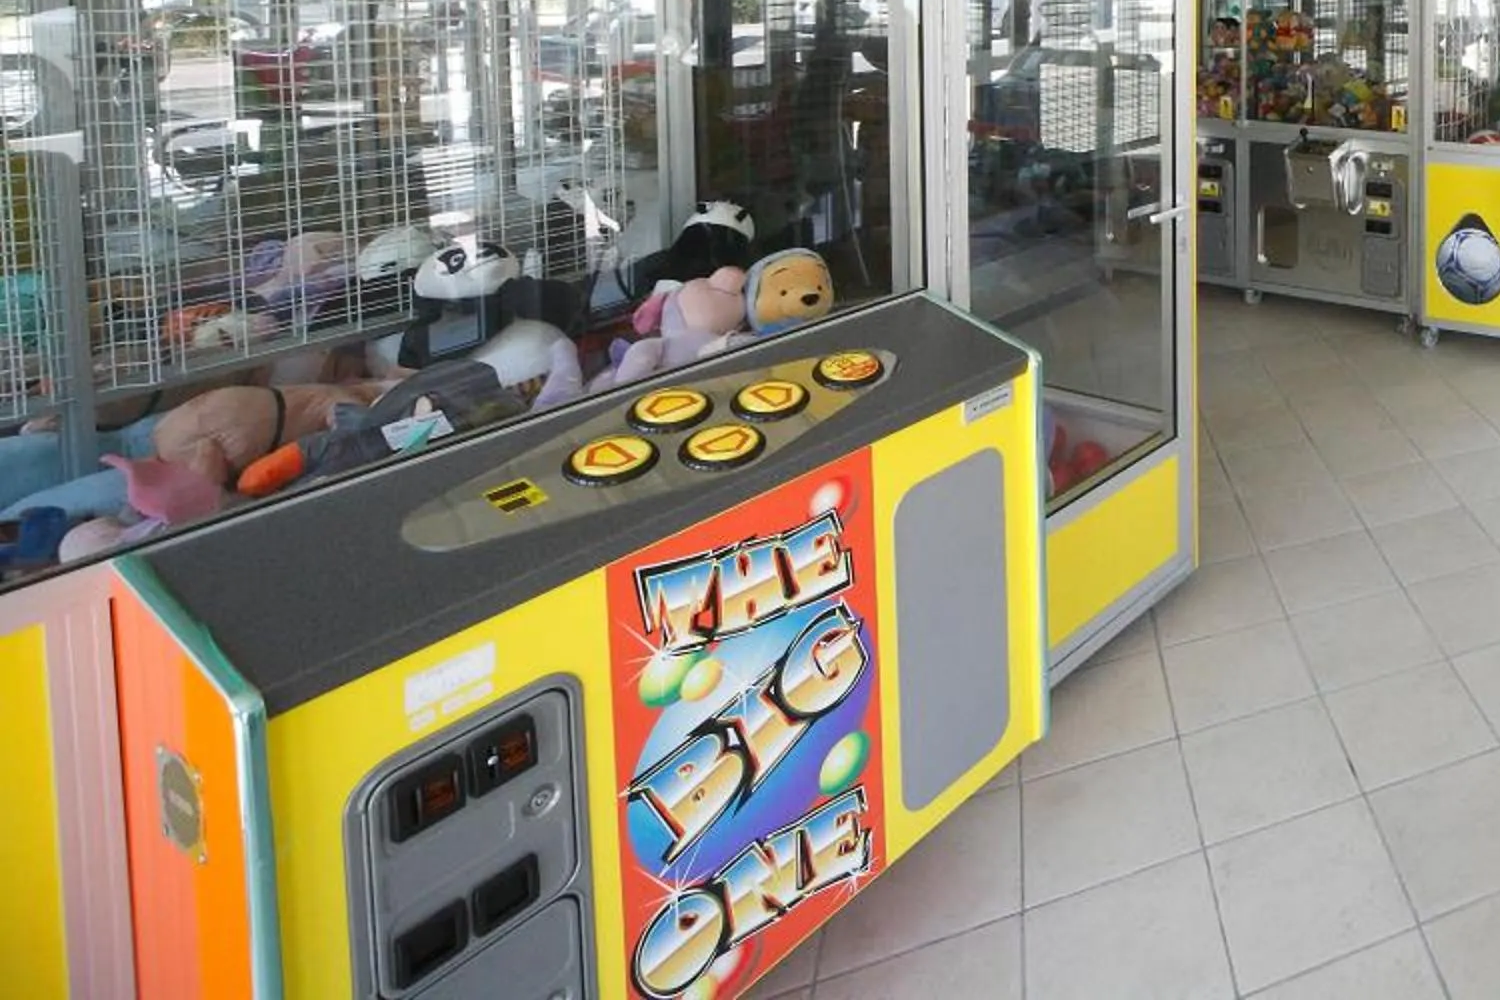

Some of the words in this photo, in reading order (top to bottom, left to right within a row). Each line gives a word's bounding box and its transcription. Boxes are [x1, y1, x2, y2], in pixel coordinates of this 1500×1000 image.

[633, 508, 855, 658] THE
[625, 597, 869, 868] BIG
[630, 786, 874, 998] ONE
